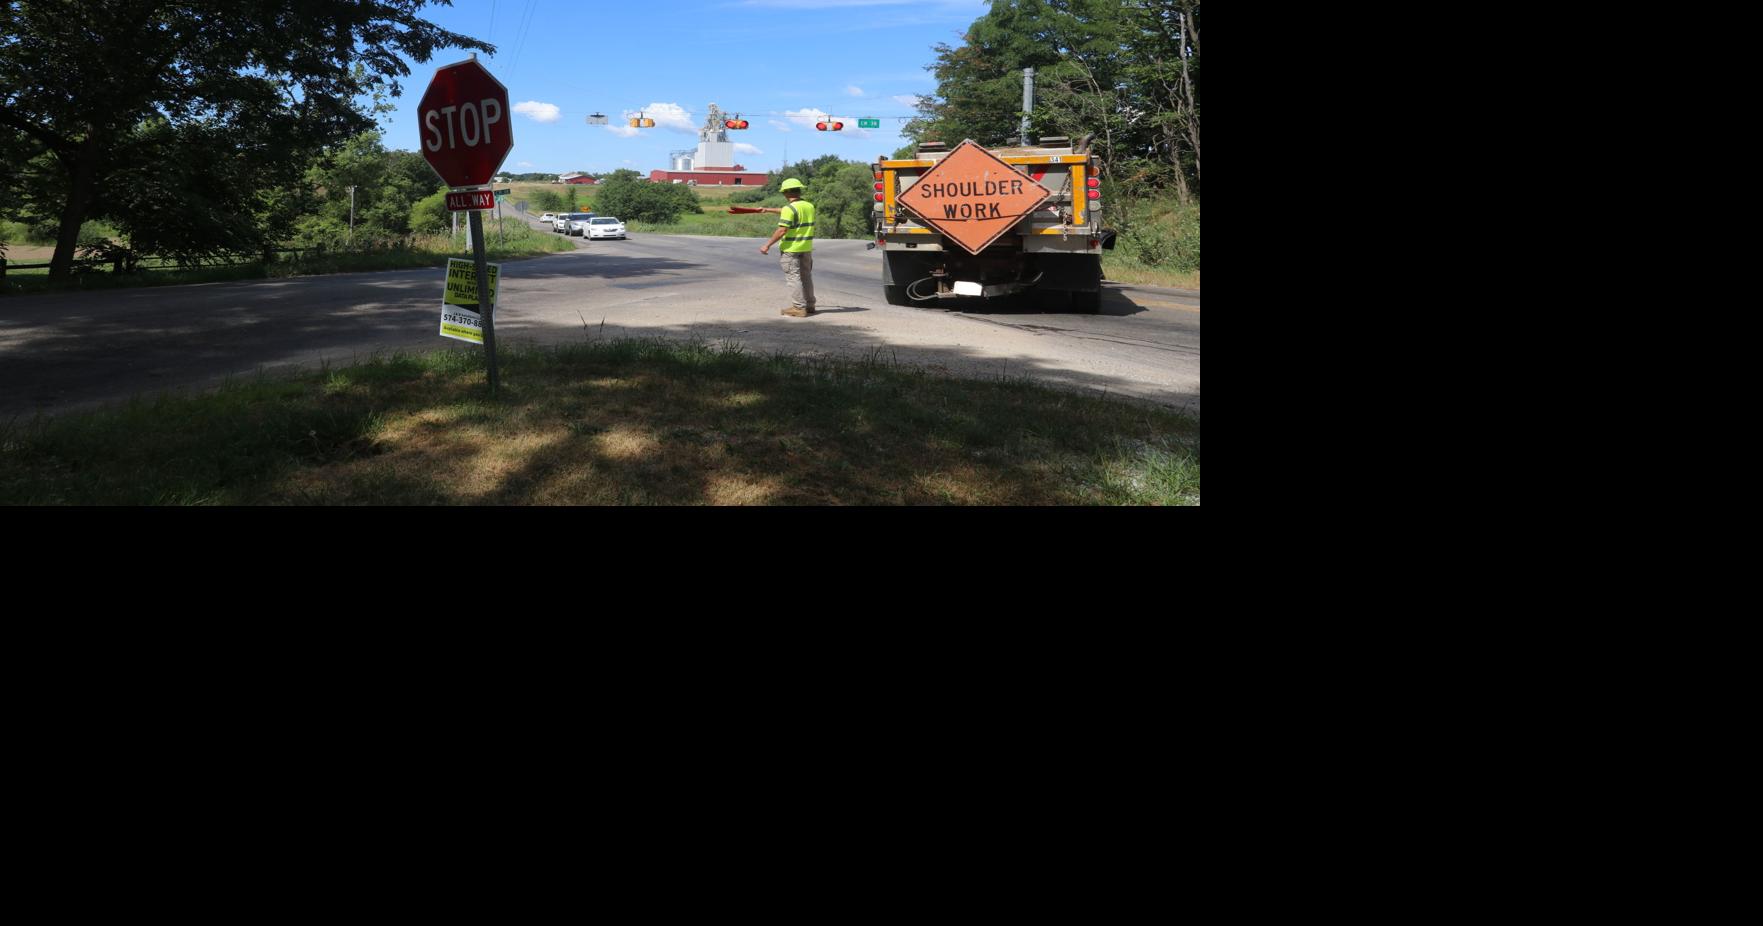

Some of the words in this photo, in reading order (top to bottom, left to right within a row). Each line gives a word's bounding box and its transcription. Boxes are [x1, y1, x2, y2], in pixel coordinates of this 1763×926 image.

[425, 97, 501, 152] STOP
[921, 179, 1023, 198] SHOULDER
[450, 195, 467, 208] ALL
[472, 193, 490, 206] WAY
[943, 202, 1001, 218] WORK
[449, 269, 496, 283] INTERT
